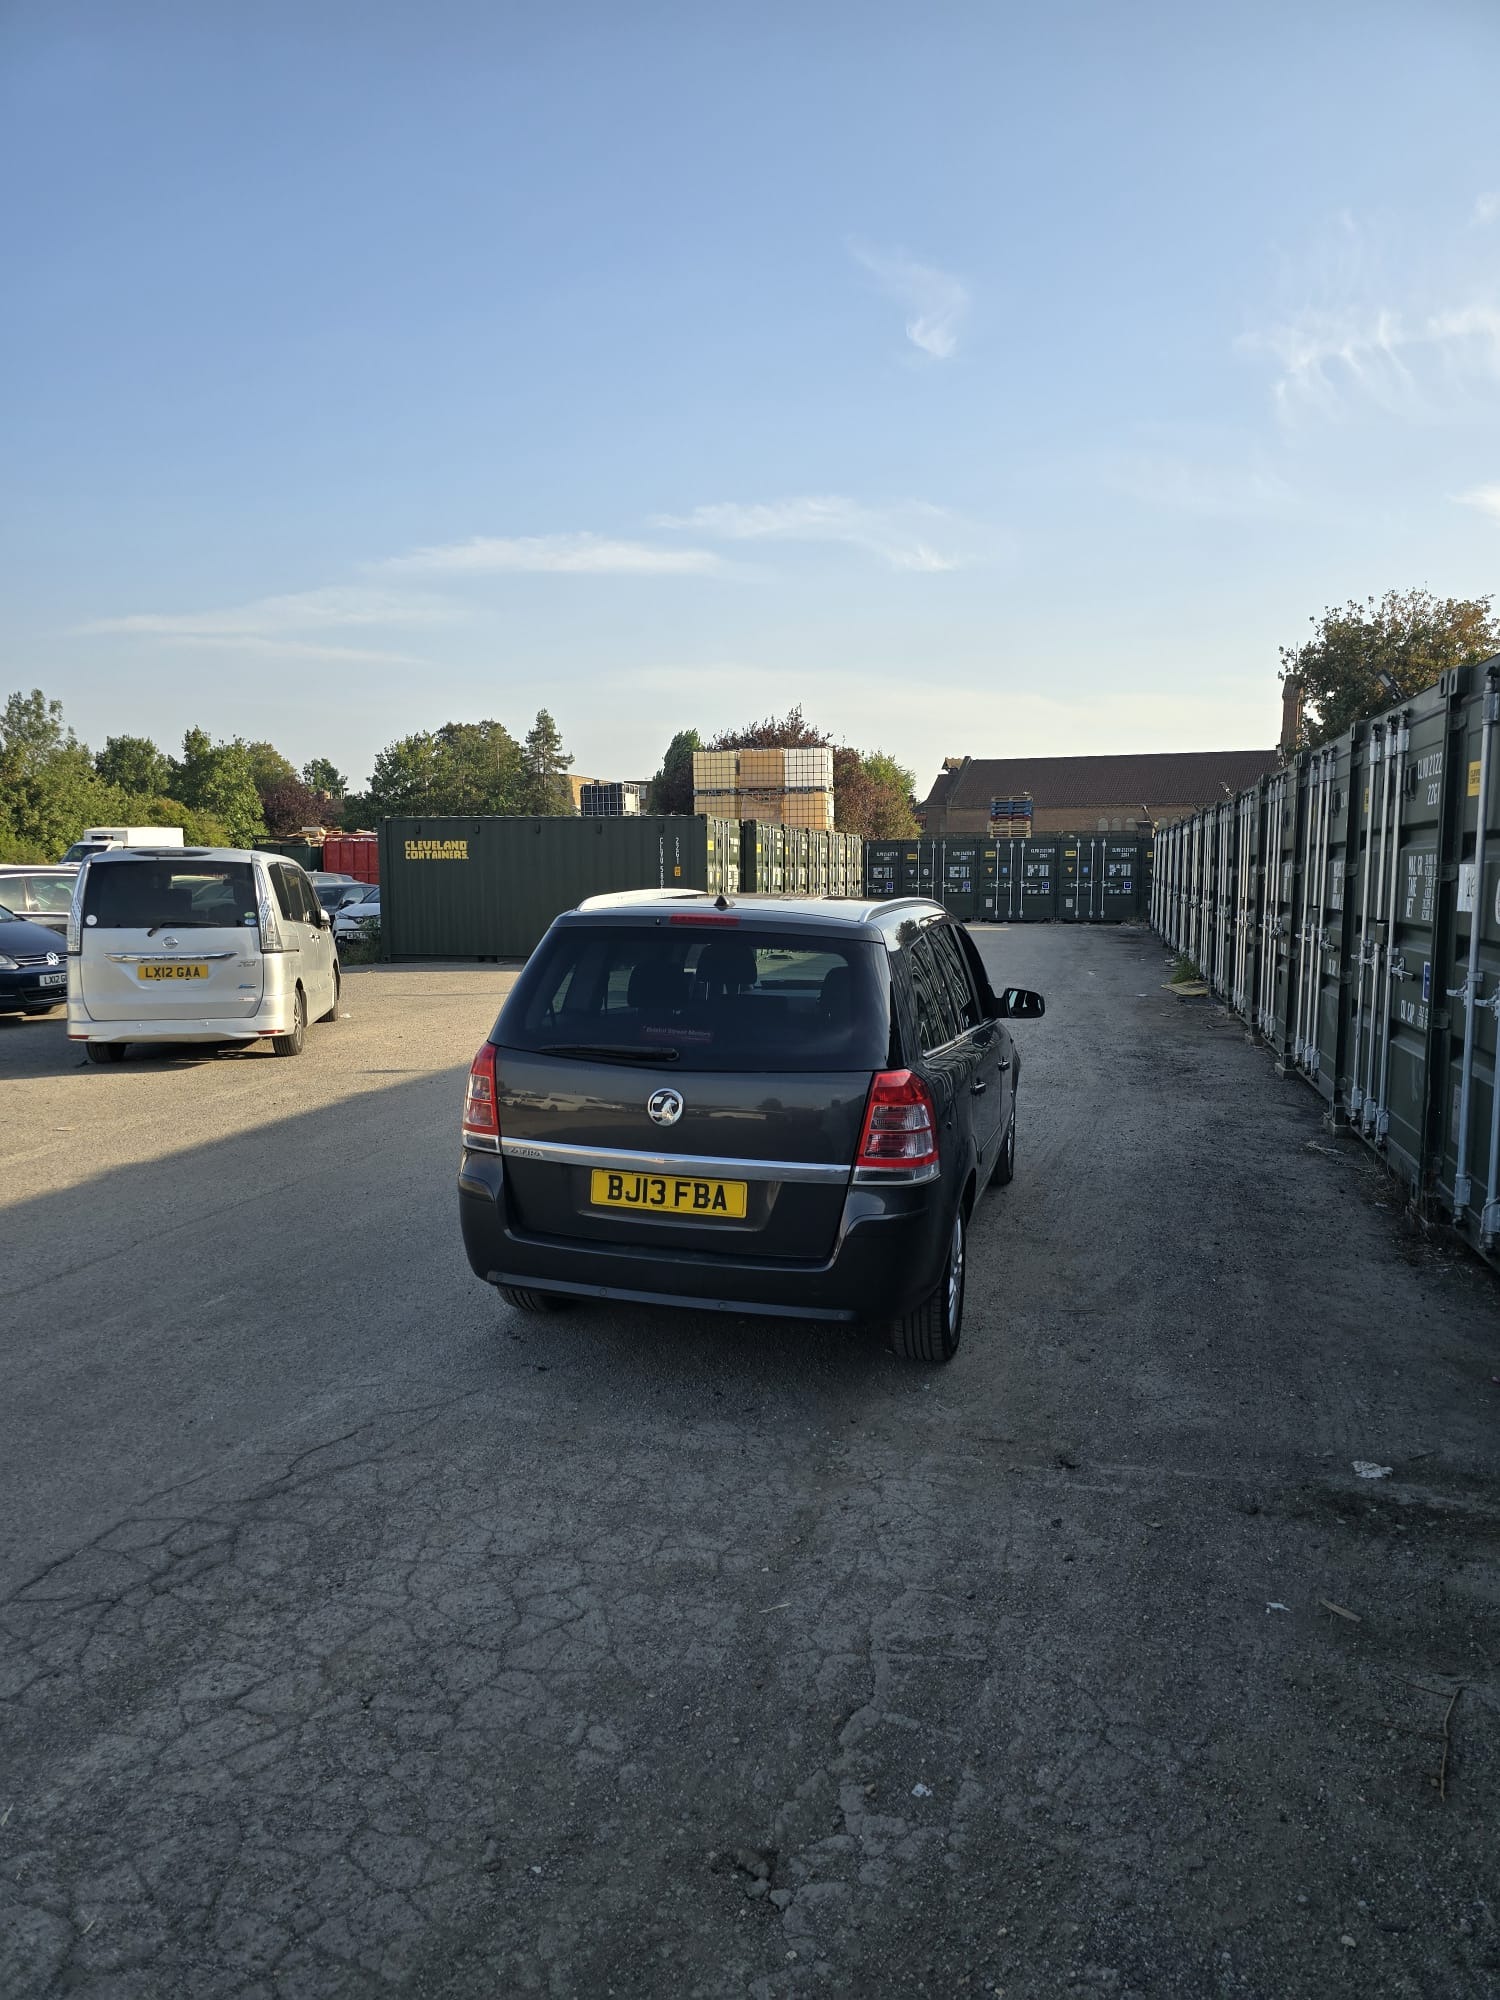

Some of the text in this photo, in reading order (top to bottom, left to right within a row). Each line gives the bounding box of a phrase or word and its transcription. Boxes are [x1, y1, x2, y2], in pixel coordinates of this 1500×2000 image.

[404, 840, 468, 850] CLEVELAND
[145, 966, 201, 978] LX12 GAA
[44, 975, 60, 985] LX12
[608, 1174, 728, 1211] BJ13 FBA
